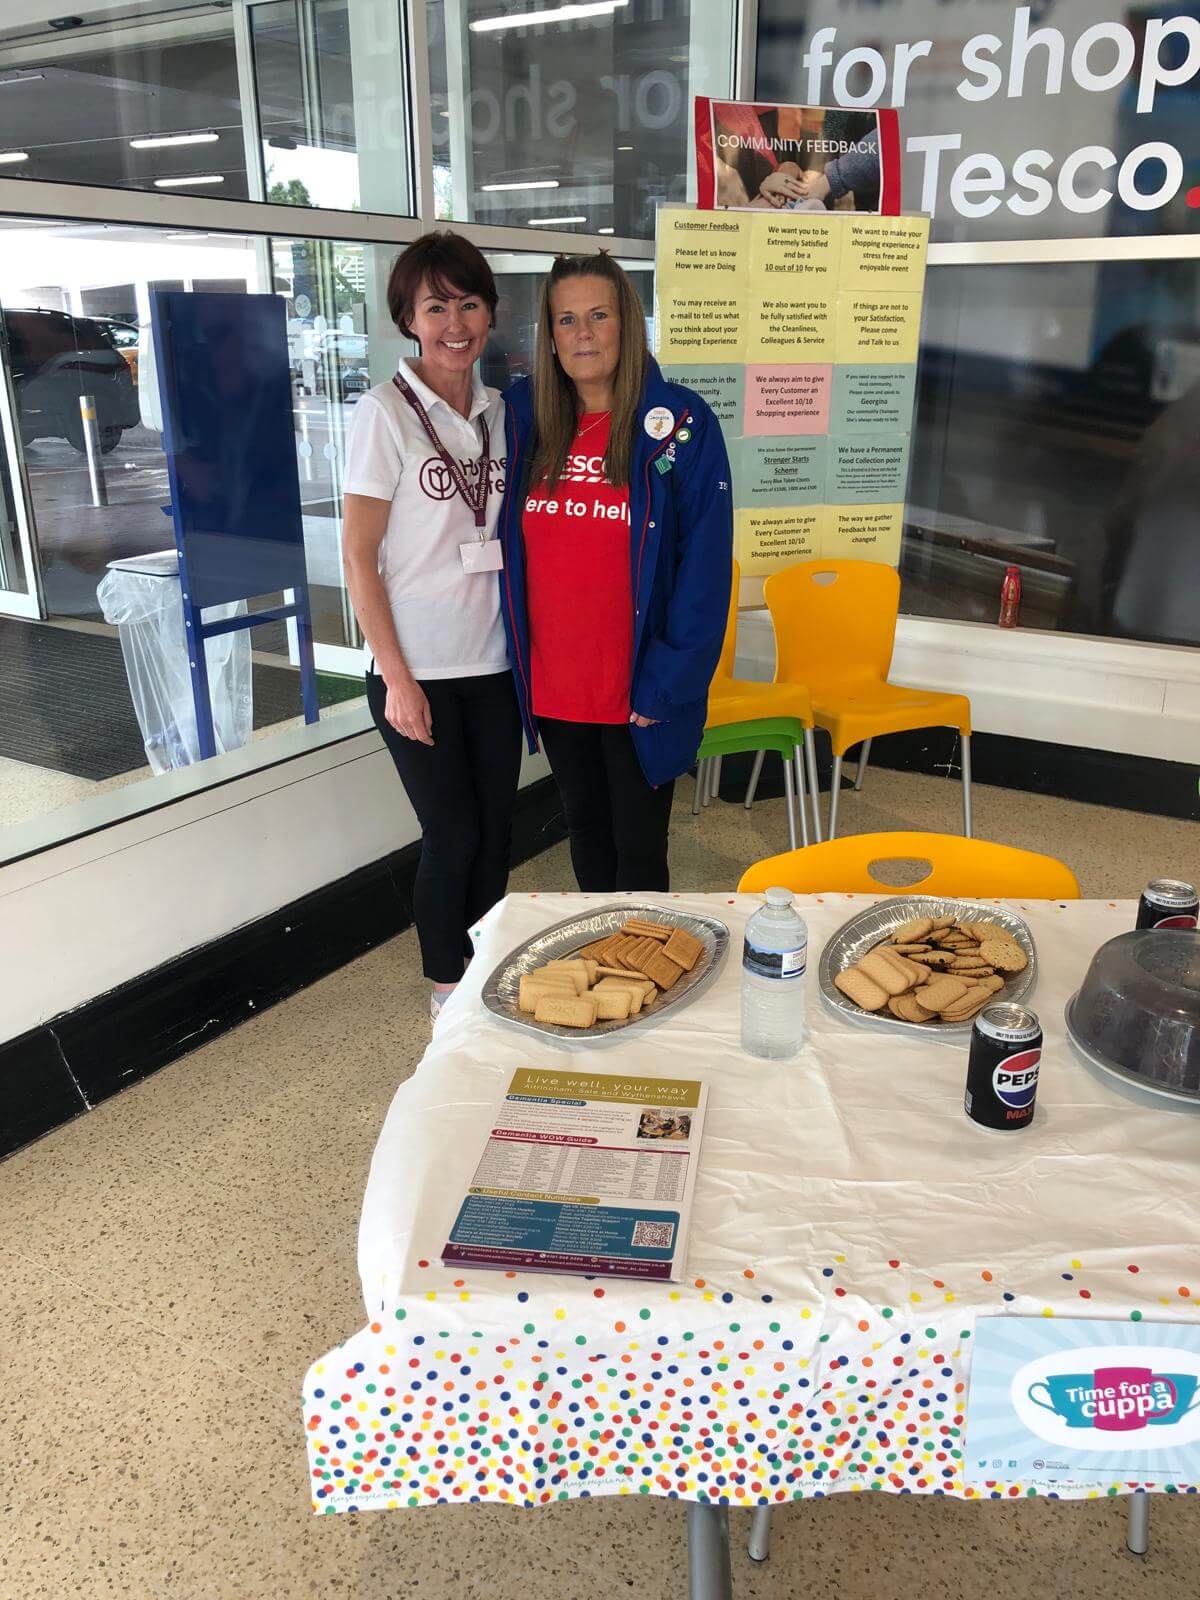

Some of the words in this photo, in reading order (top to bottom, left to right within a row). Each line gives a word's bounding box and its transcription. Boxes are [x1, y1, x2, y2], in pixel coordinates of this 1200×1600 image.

[803, 27, 933, 107] for
[956, 6, 1200, 114] shop
[717, 134, 803, 153] COMMUNITY
[807, 139, 877, 154] FEEDBACK
[674, 222, 708, 230] Customer
[709, 223, 740, 231] Feedback
[767, 239, 800, 247] Extremely
[852, 239, 880, 248] shopping
[717, 263, 736, 272] Doing
[765, 263, 774, 271] 10
[788, 264, 795, 272] of
[860, 264, 890, 272] enjoyable
[859, 303, 878, 311] things
[770, 313, 785, 322] fully
[870, 315, 906, 323] Satisfaction,
[782, 325, 818, 333] Cleanliness,
[670, 338, 701, 346] Shopping
[760, 337, 795, 345] Colleagues
[812, 376, 824, 384] give
[795, 398, 813, 406] 10/10
[861, 398, 888, 406] Georgina
[792, 456, 810, 464] Starts
[774, 467, 798, 475] Scheme
[451, 465, 467, 489] Instead
[464, 490, 475, 506] Home
[479, 484, 487, 509] Instead
[525, 496, 559, 514] ere
[565, 498, 587, 516] to
[527, 1075, 559, 1084] Live
[614, 1082, 650, 1092] your
[658, 1086, 689, 1095] way
[509, 1095, 548, 1103] Dementia
[621, 1091, 686, 1100] Wythenshawe
[496, 1130, 537, 1138] Dementia
[510, 1191, 543, 1199] Contact
[544, 1193, 582, 1202] Numbers
[1066, 1386, 1116, 1403] Time
[1119, 1382, 1150, 1398] for
[1155, 1381, 1167, 1393] a
[1081, 1393, 1175, 1420] cuppa
